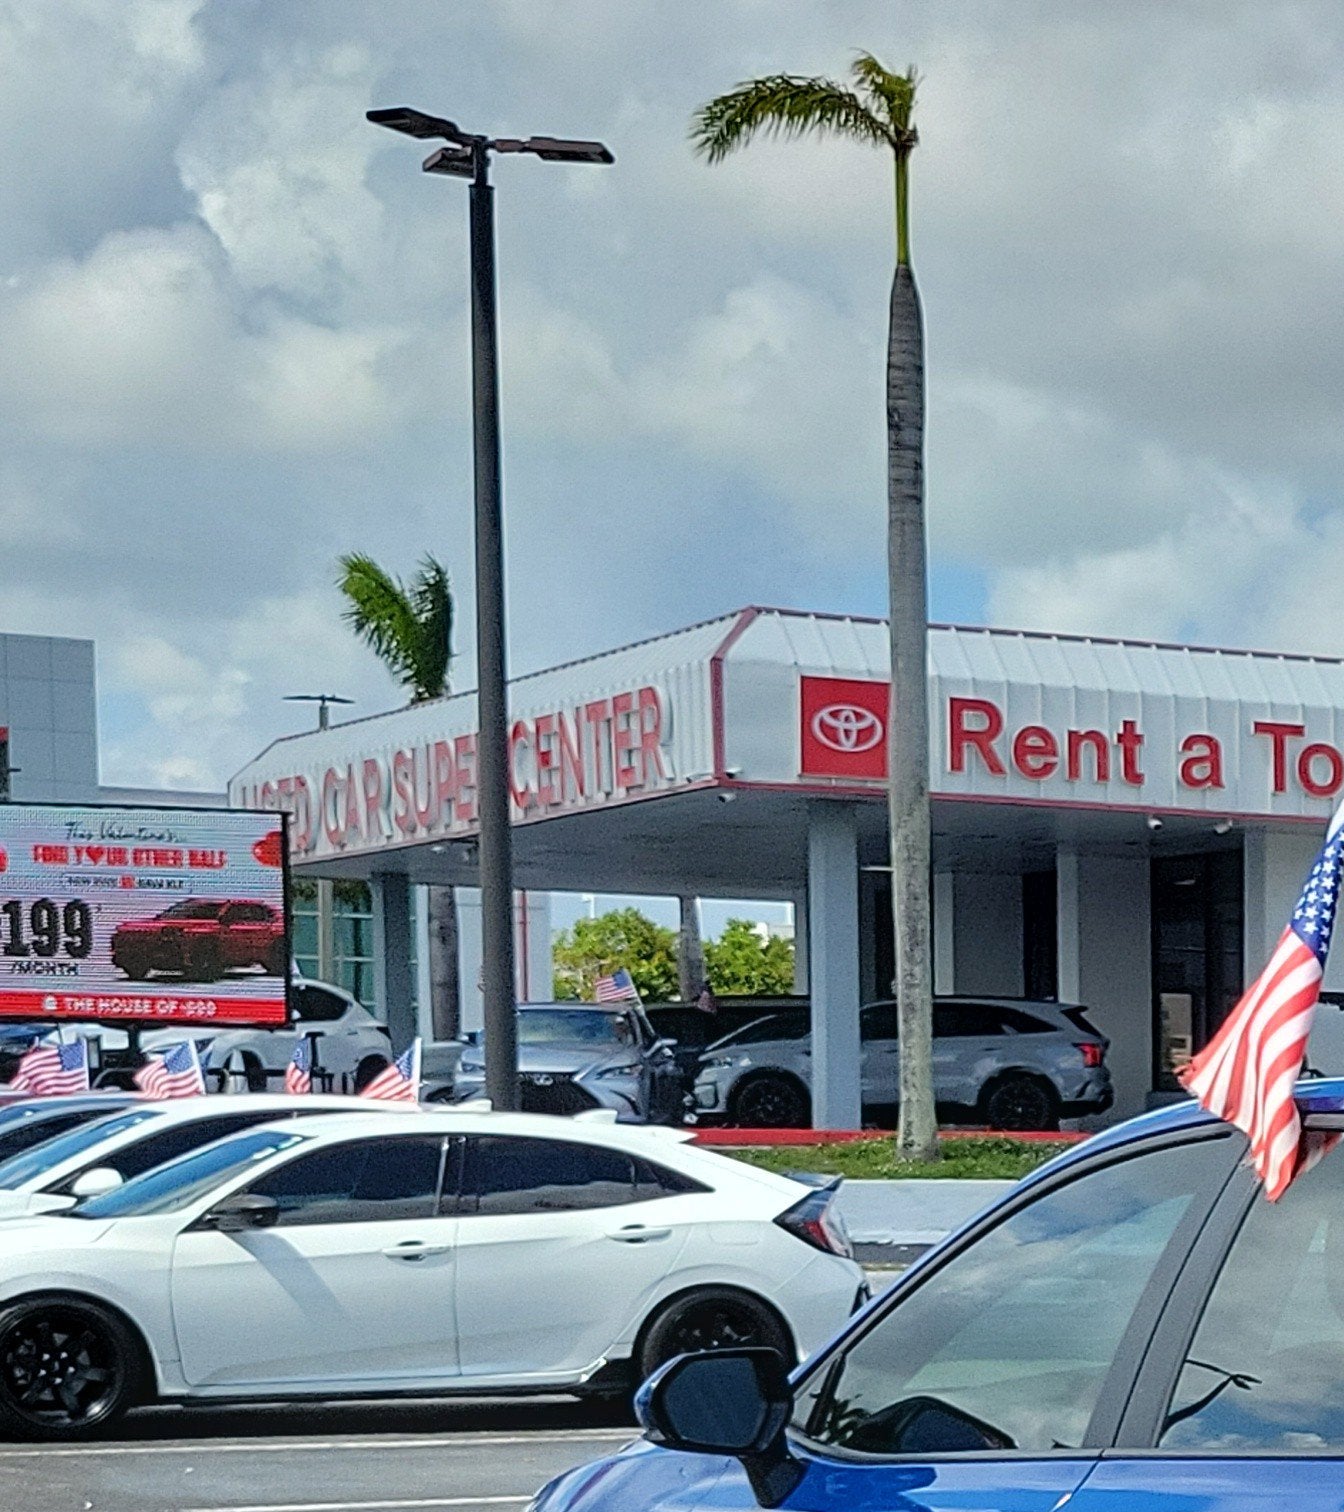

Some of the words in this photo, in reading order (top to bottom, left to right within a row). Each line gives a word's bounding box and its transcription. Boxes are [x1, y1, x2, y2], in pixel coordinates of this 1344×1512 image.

[323, 757, 395, 847] CAR
[393, 731, 480, 833] SUPE
[508, 684, 676, 810] CENTER
[948, 696, 1146, 787] Rent
[1178, 733, 1224, 789] a
[64, 997, 95, 1012] THE
[98, 998, 152, 1014] HOUSE
[156, 999, 180, 1014] OF
